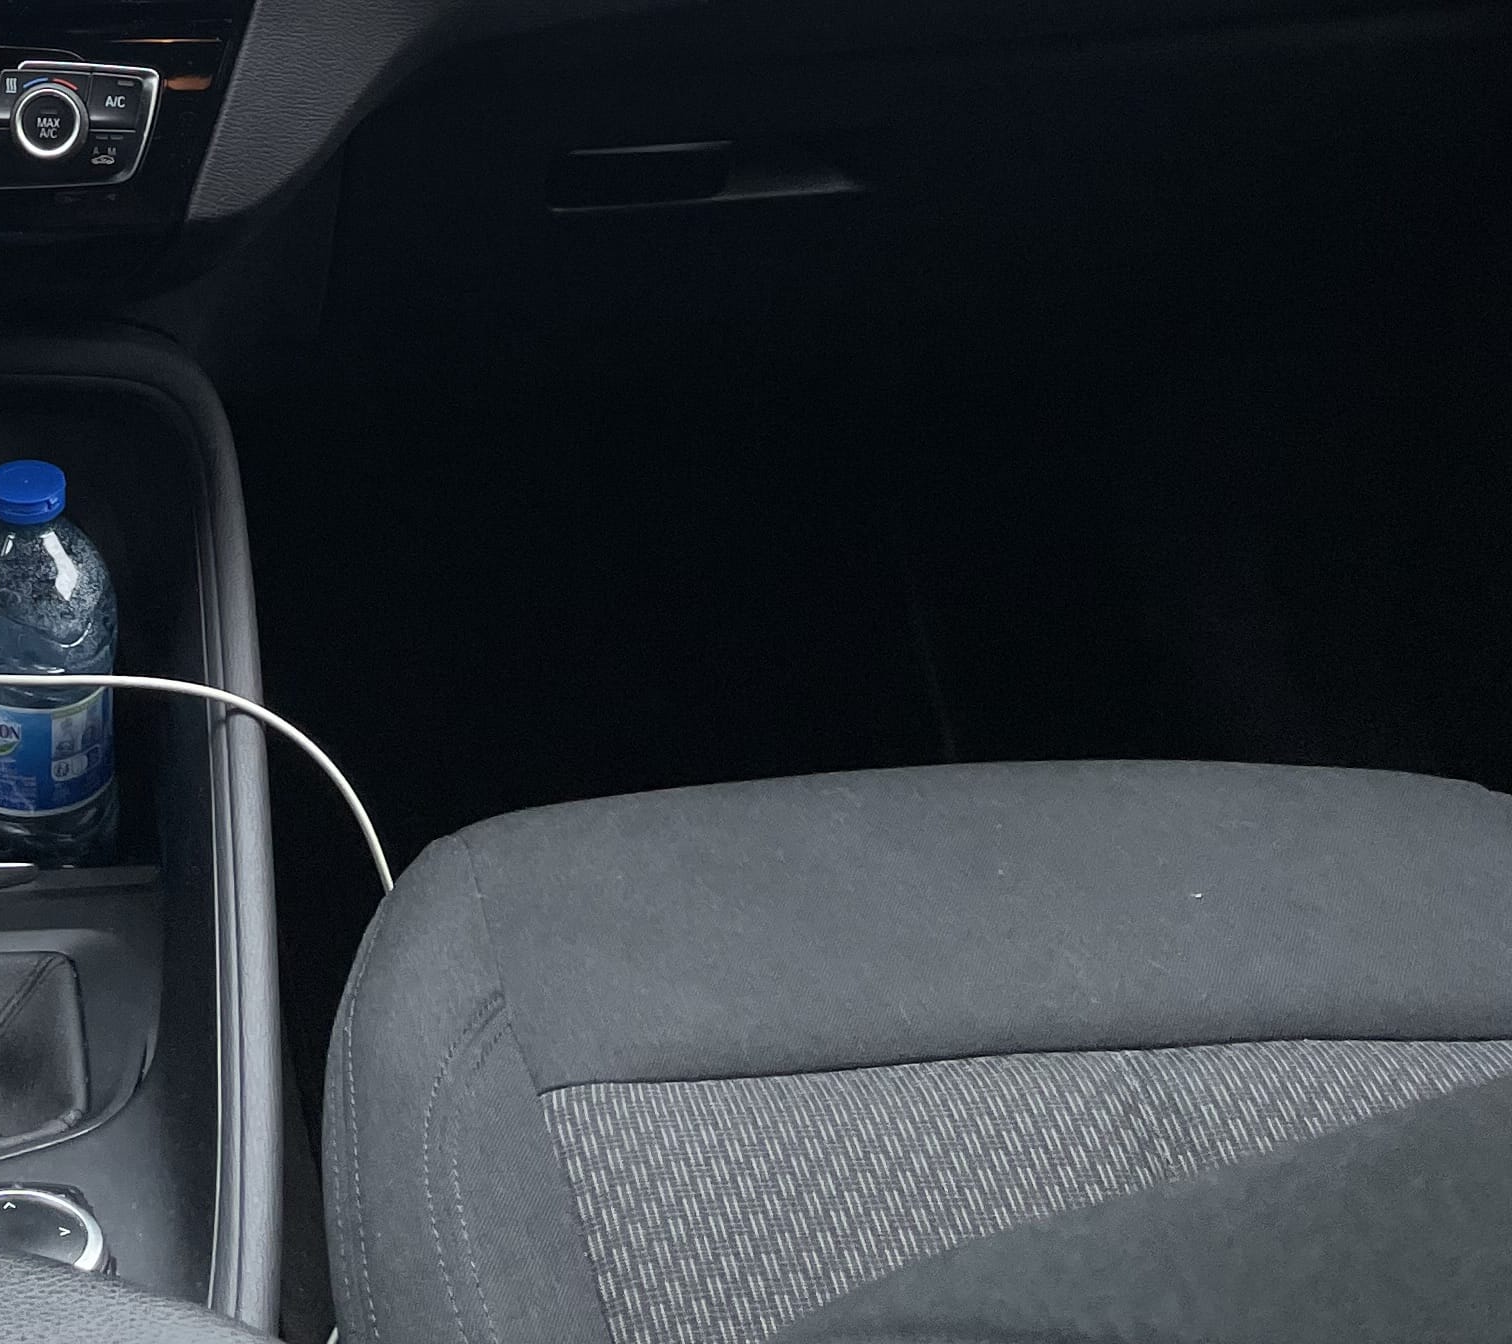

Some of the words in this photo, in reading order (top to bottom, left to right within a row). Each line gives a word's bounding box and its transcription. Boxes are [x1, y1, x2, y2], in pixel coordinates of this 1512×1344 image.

[105, 95, 126, 108] A/C
[36, 116, 61, 128] MAX
[39, 127, 58, 139] A/C
